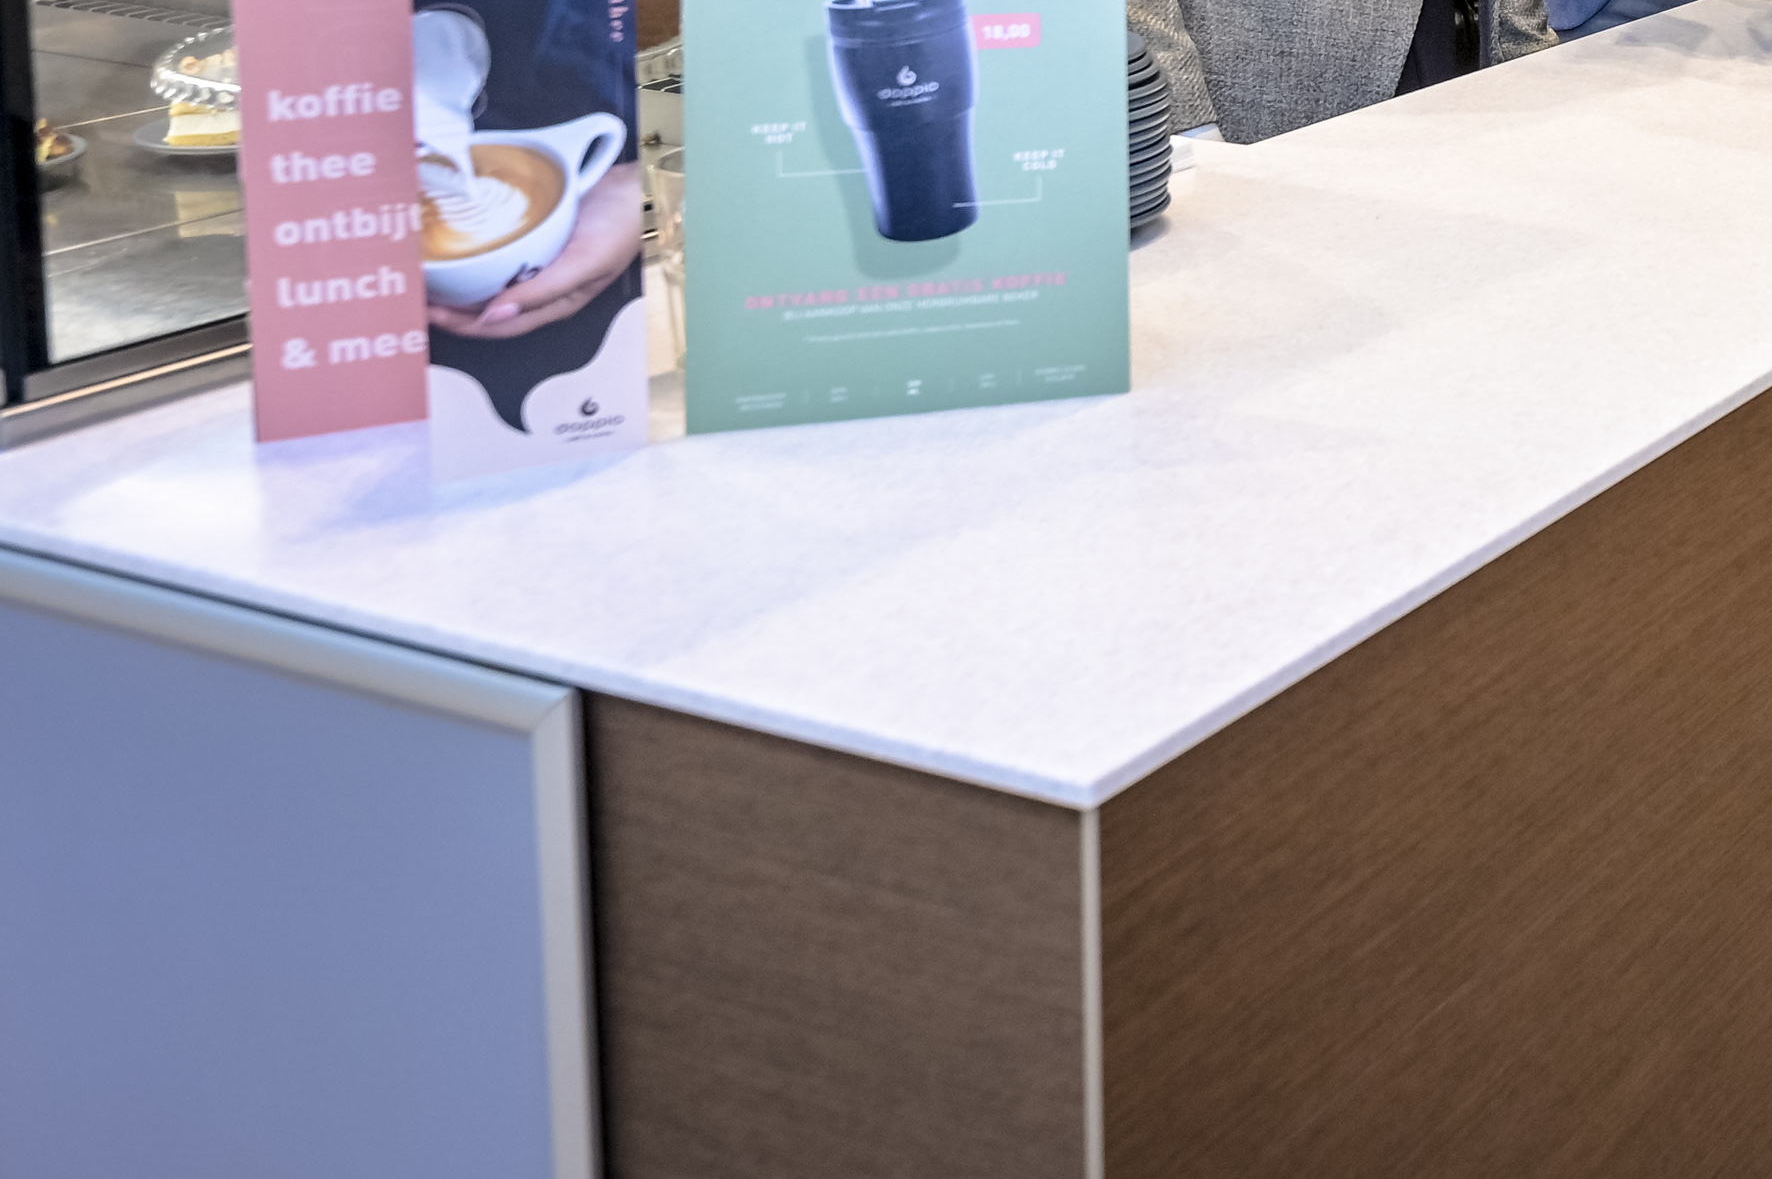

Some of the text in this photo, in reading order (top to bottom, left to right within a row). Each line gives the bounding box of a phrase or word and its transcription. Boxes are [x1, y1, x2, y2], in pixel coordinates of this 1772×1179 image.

[266, 83, 404, 122] koffie
[269, 150, 377, 184] thee
[275, 265, 407, 308] lunch
[281, 336, 318, 370] &
